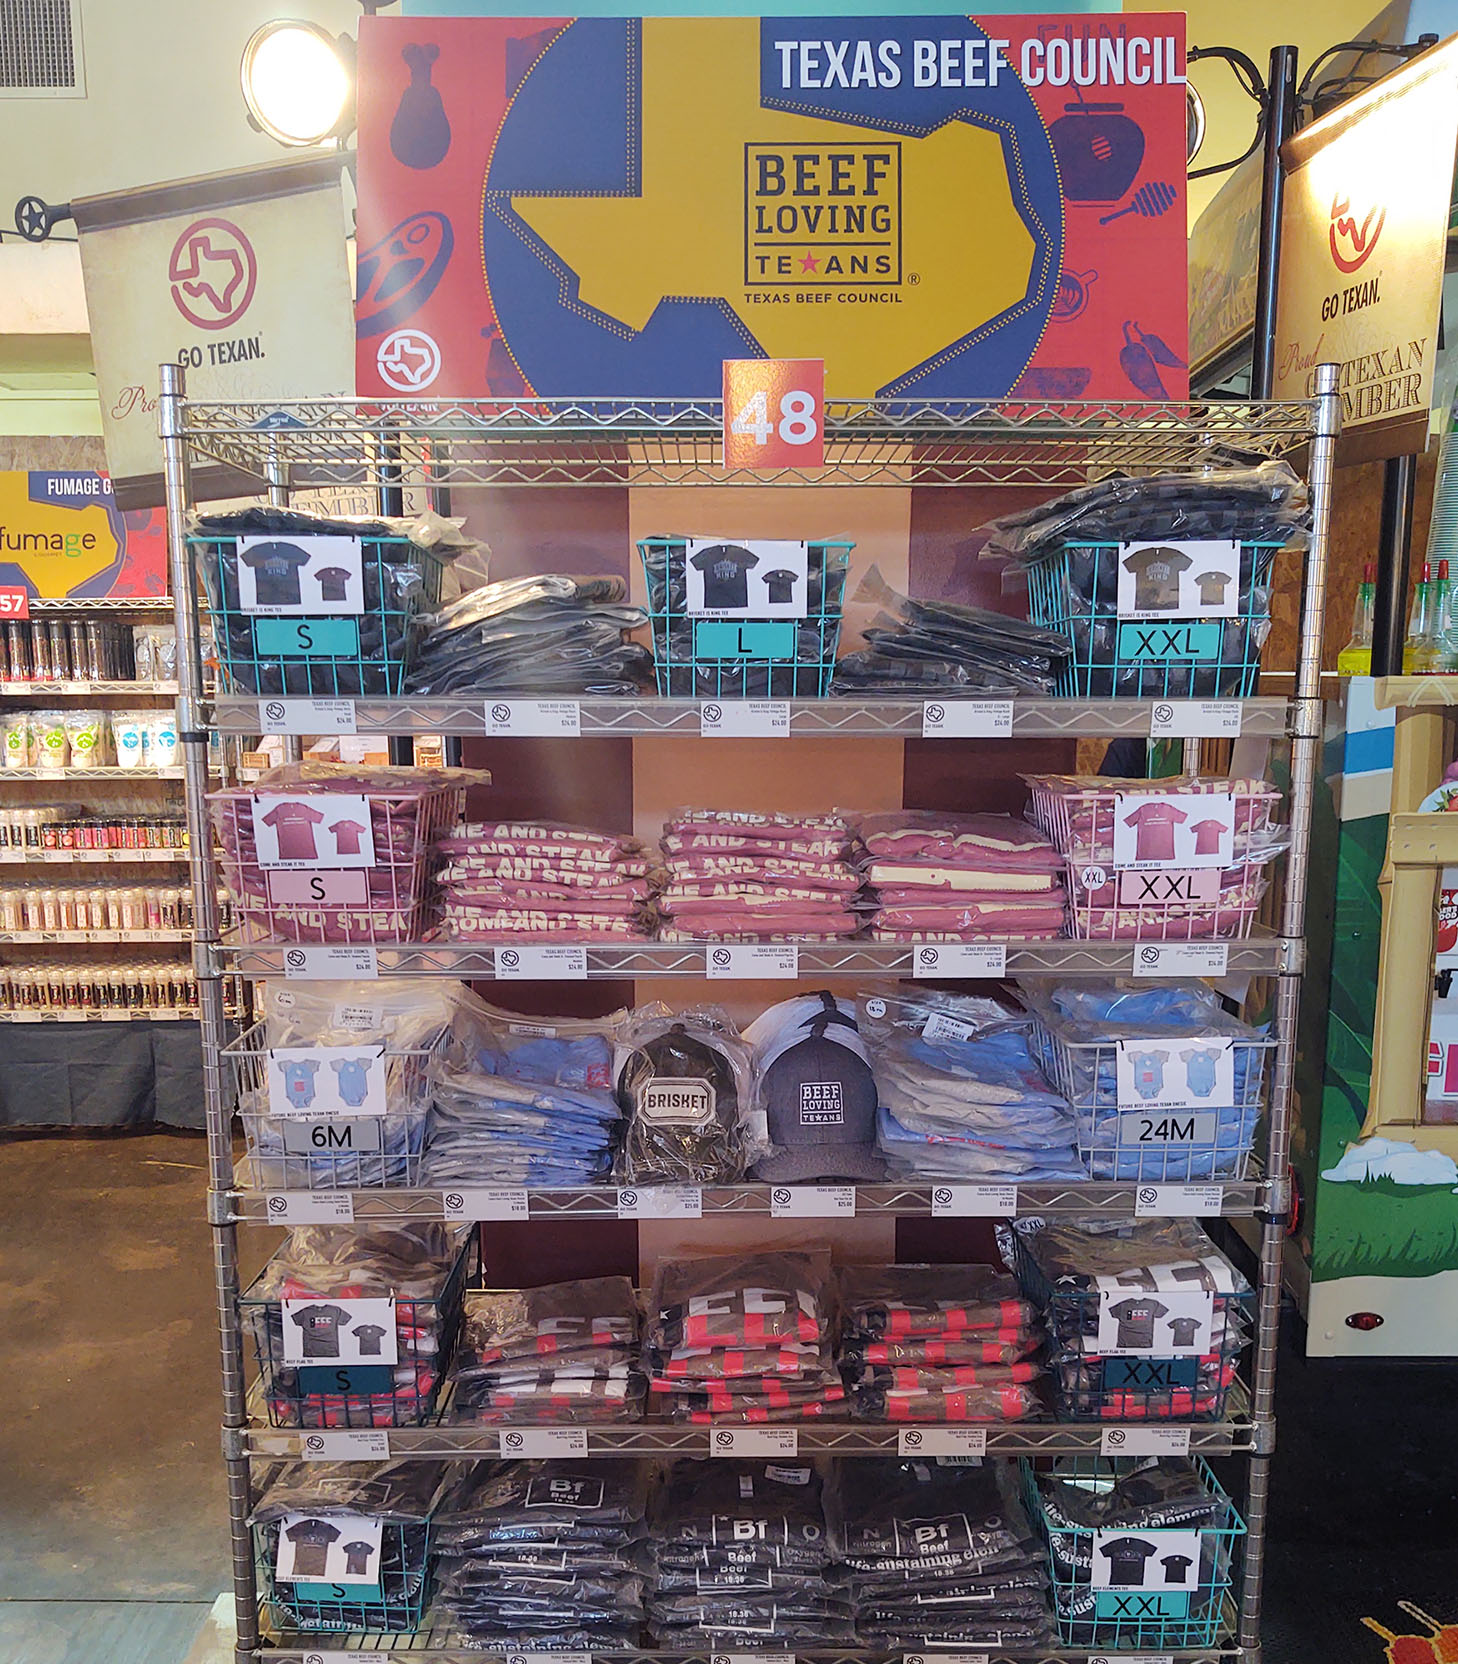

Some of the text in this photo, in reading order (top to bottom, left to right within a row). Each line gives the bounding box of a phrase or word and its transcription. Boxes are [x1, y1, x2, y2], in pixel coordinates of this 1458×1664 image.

[774, 36, 1186, 88] TEXAS BEEF COUNCIL
[755, 154, 890, 196] BEEF
[755, 205, 891, 233] LOVING
[744, 293, 902, 303] TEXAS BEEF COUNCIL
[1321, 293, 1338, 322] GO
[177, 346, 202, 369] GO
[111, 385, 158, 420] Pro
[1341, 372, 1422, 422] MBER
[731, 390, 817, 446] 48
[47, 478, 114, 495] FUMAGE G
[297, 625, 313, 649] S
[738, 627, 752, 653] L
[1134, 628, 1200, 656] XXL
[494, 824, 547, 839] AND
[310, 877, 326, 901] S
[1084, 871, 1103, 884] XXL
[1138, 875, 1201, 900] XXL
[648, 1093, 707, 1109] BRISKET
[802, 1085, 839, 1099] BEEF
[802, 1099, 841, 1111] LOVING
[311, 1125, 352, 1148] 6M
[1139, 1118, 1195, 1141] 24M
[335, 1370, 351, 1391] S
[1122, 1362, 1180, 1385] XXL
[550, 1479, 586, 1492] Bf
[733, 1520, 769, 1540] Bf
[914, 1523, 949, 1544] Bf
[728, 1551, 757, 1563] Beef
[919, 1540, 949, 1555] Beef
[332, 1583, 346, 1598] S
[1113, 1596, 1170, 1616] XXL
